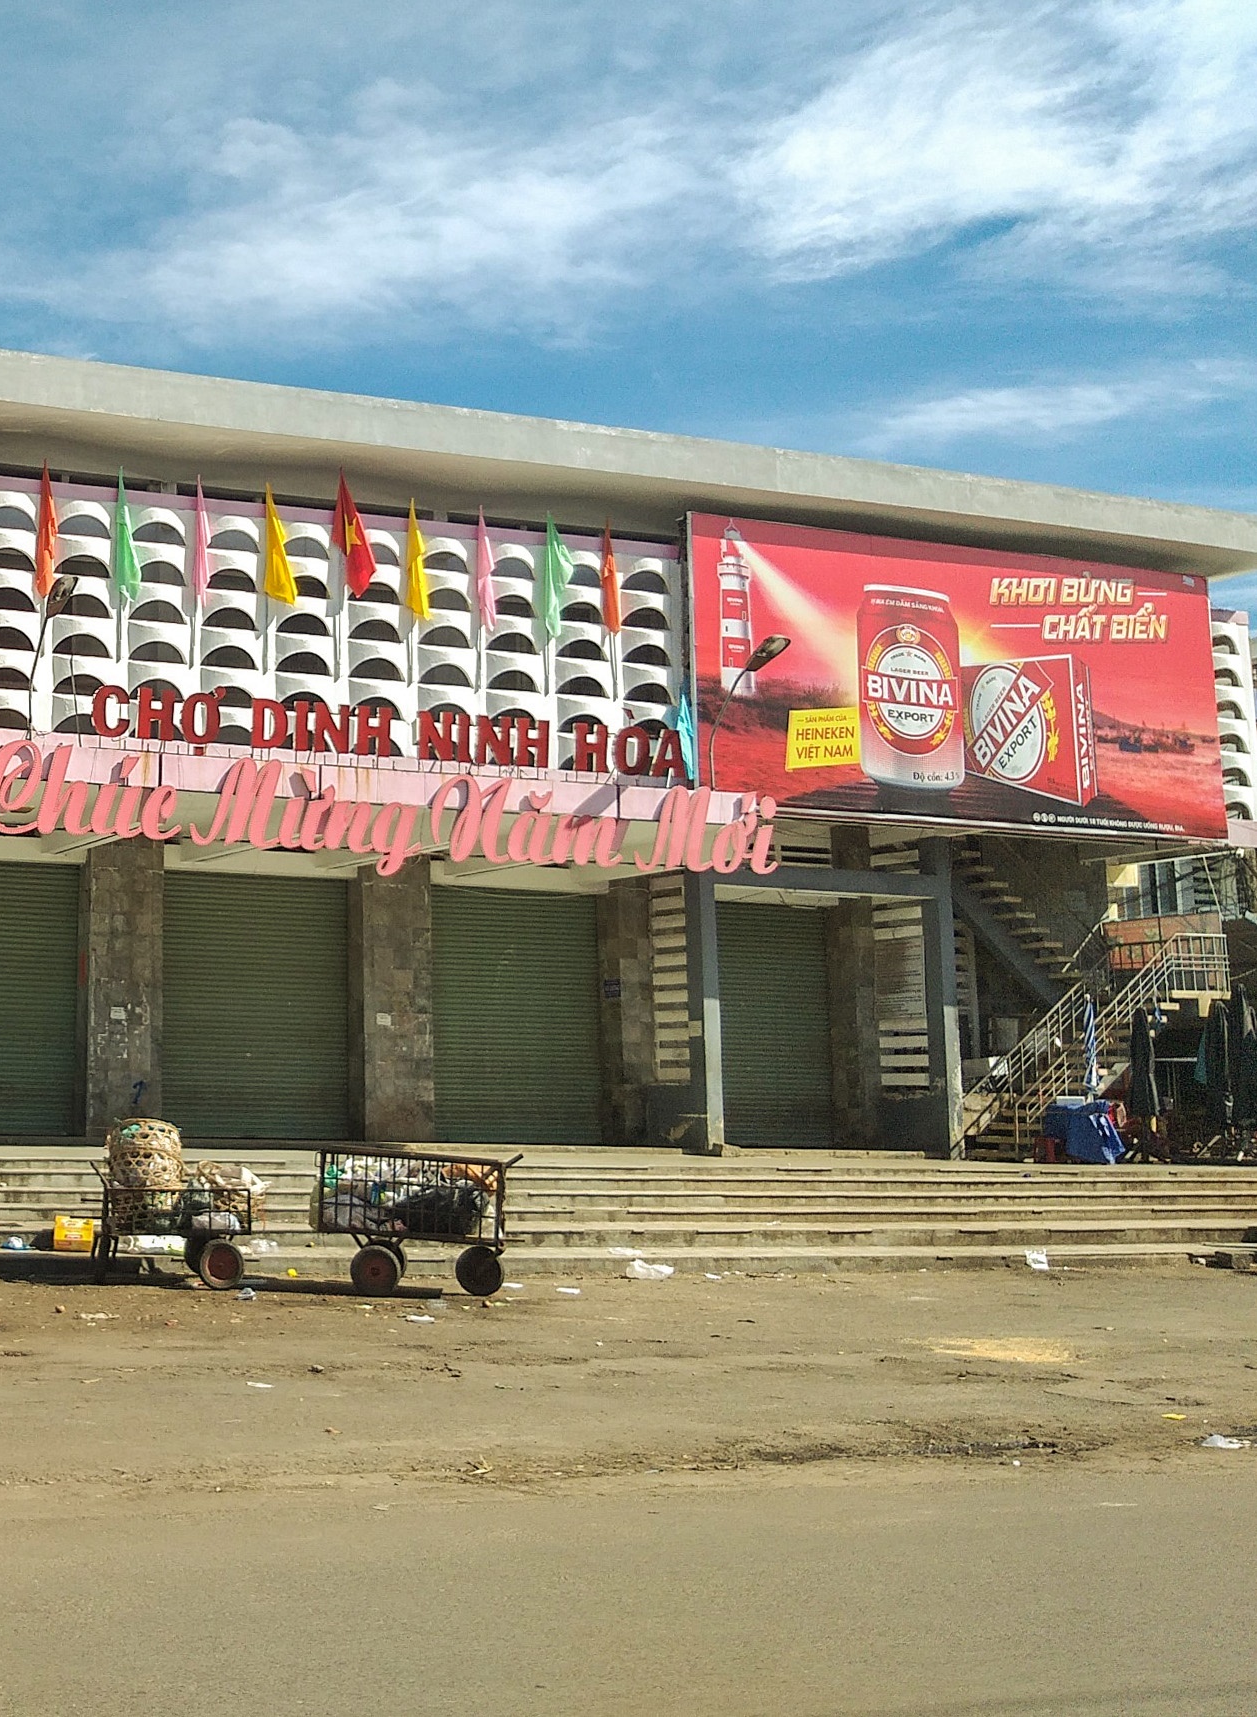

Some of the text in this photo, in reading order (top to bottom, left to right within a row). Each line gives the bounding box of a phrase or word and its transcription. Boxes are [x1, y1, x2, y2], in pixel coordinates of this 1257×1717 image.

[990, 571, 1134, 605] KHƠI BỪNG
[1041, 602, 1168, 642] CHẤT BIỂN
[867, 674, 953, 706] BIVINA
[92, 684, 227, 756] CHỢ
[251, 698, 392, 757] DINH
[416, 710, 549, 768] NINH
[796, 726, 855, 741] HEINEKEN
[887, 709, 935, 722] EXPORT
[973, 675, 1041, 768] BIVINA
[796, 744, 853, 762] VIỆT NAM
[998, 715, 1038, 770] EXPORT
[1076, 682, 1090, 789] BIVINA
[913, 772, 925, 782] Độ
[190, 756, 422, 876] Mừng
[430, 774, 623, 867] Năm
[634, 785, 778, 875] Mới
